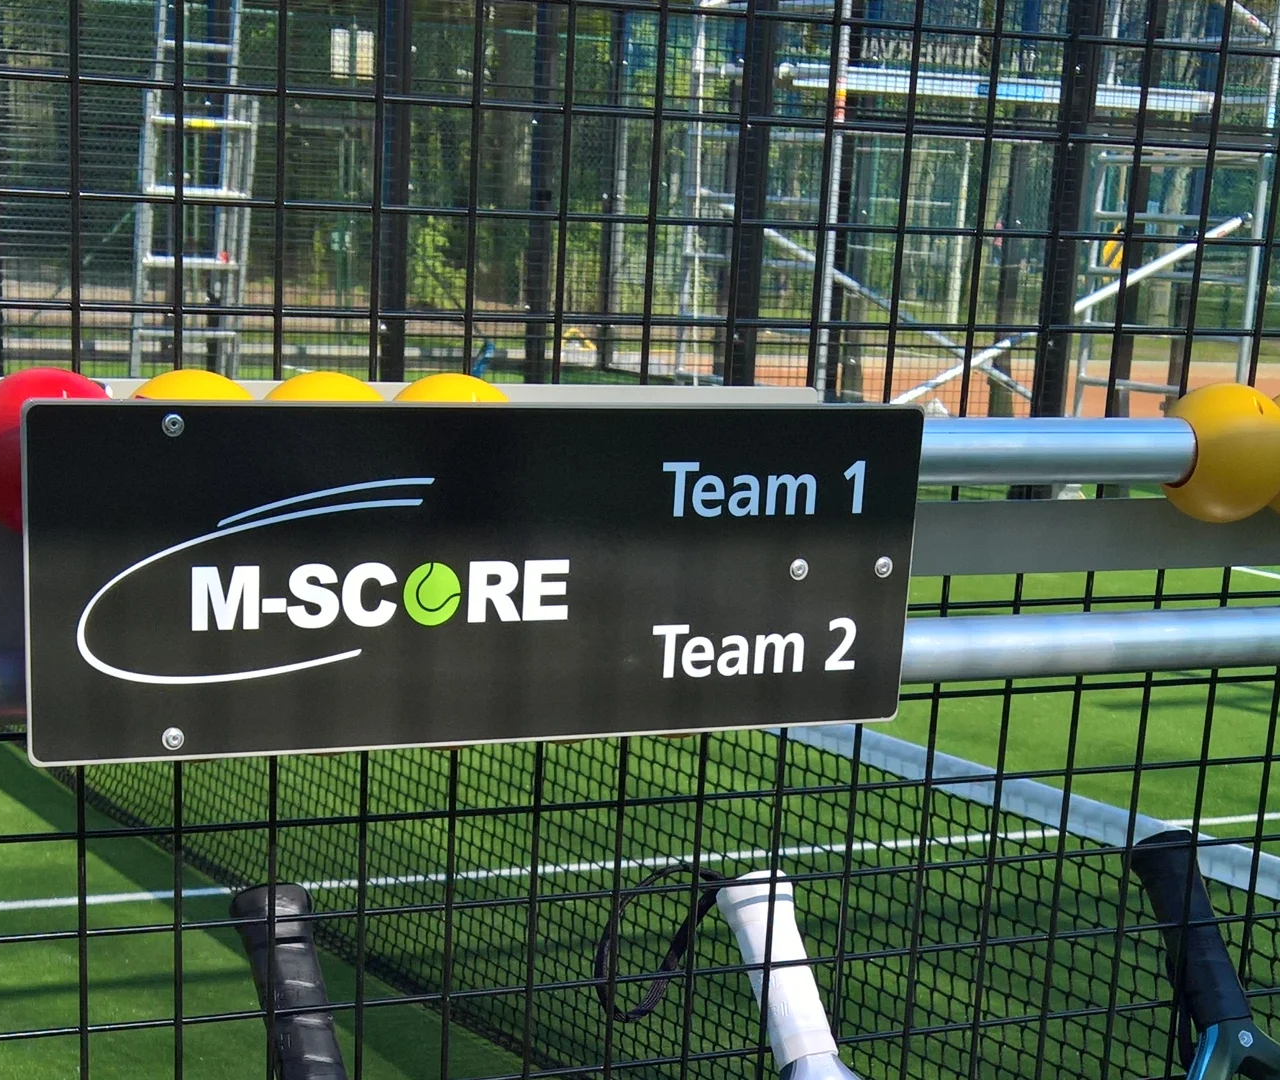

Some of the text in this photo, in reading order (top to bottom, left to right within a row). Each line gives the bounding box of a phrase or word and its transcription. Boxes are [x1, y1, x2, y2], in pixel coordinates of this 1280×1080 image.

[663, 460, 867, 518] Team 1
[652, 618, 857, 680] Team 2
